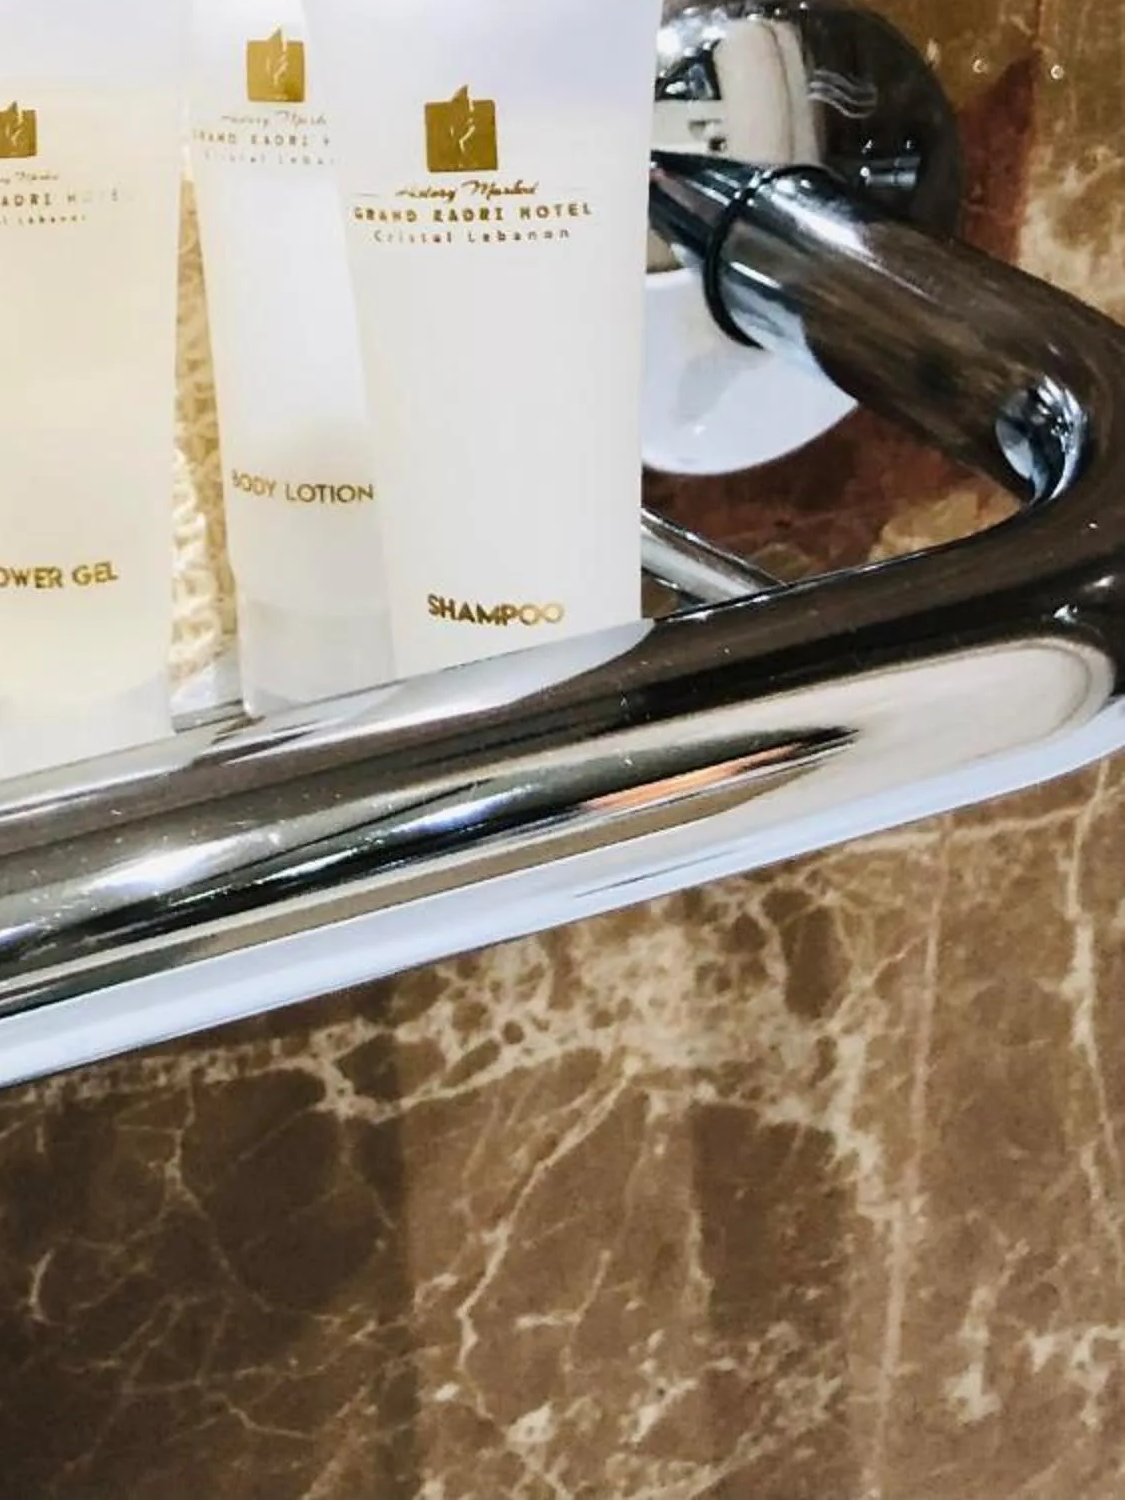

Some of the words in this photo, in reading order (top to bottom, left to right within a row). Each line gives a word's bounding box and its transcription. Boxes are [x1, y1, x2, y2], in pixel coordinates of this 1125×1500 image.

[354, 206, 418, 223] GRAND
[432, 206, 504, 223] KADRI
[520, 201, 593, 221] HOTEL
[374, 230, 452, 244] Cristal
[285, 482, 374, 504] LOTION
[71, 560, 120, 587] GEL
[427, 593, 565, 627] SHAMPOO
